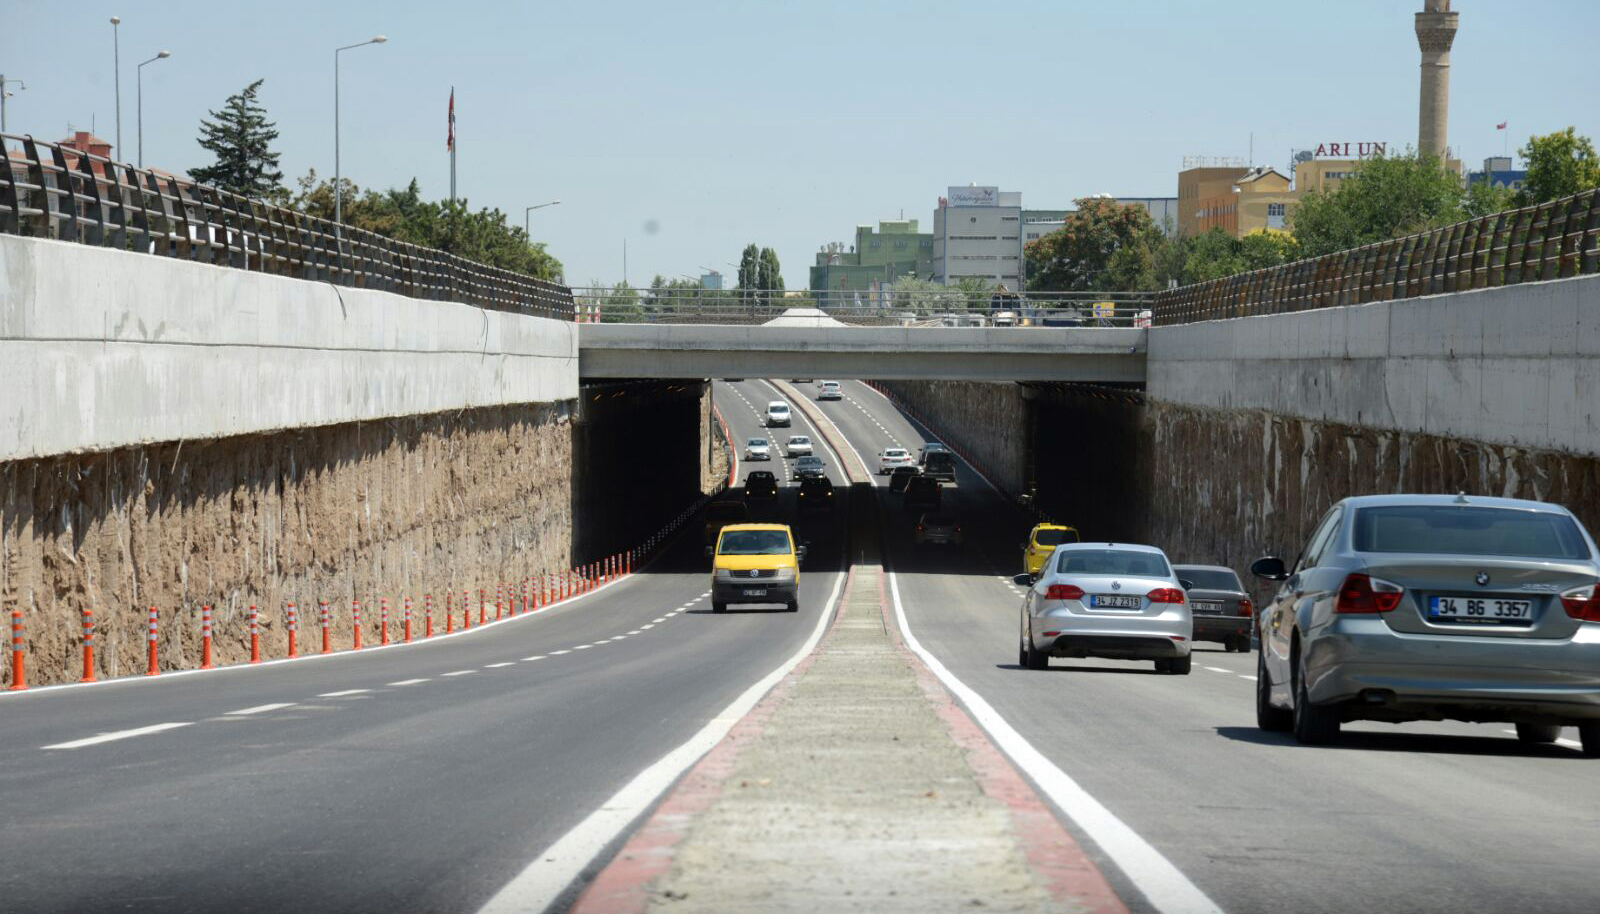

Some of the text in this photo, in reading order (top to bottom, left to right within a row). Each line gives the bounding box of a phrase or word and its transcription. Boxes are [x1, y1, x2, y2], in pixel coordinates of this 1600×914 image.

[1315, 142, 1386, 156] ARI UN
[1096, 596, 1106, 605] 34
[1109, 597, 1118, 606] JZ
[1440, 599, 1457, 614] 34
[1494, 601, 1530, 617] 3357
